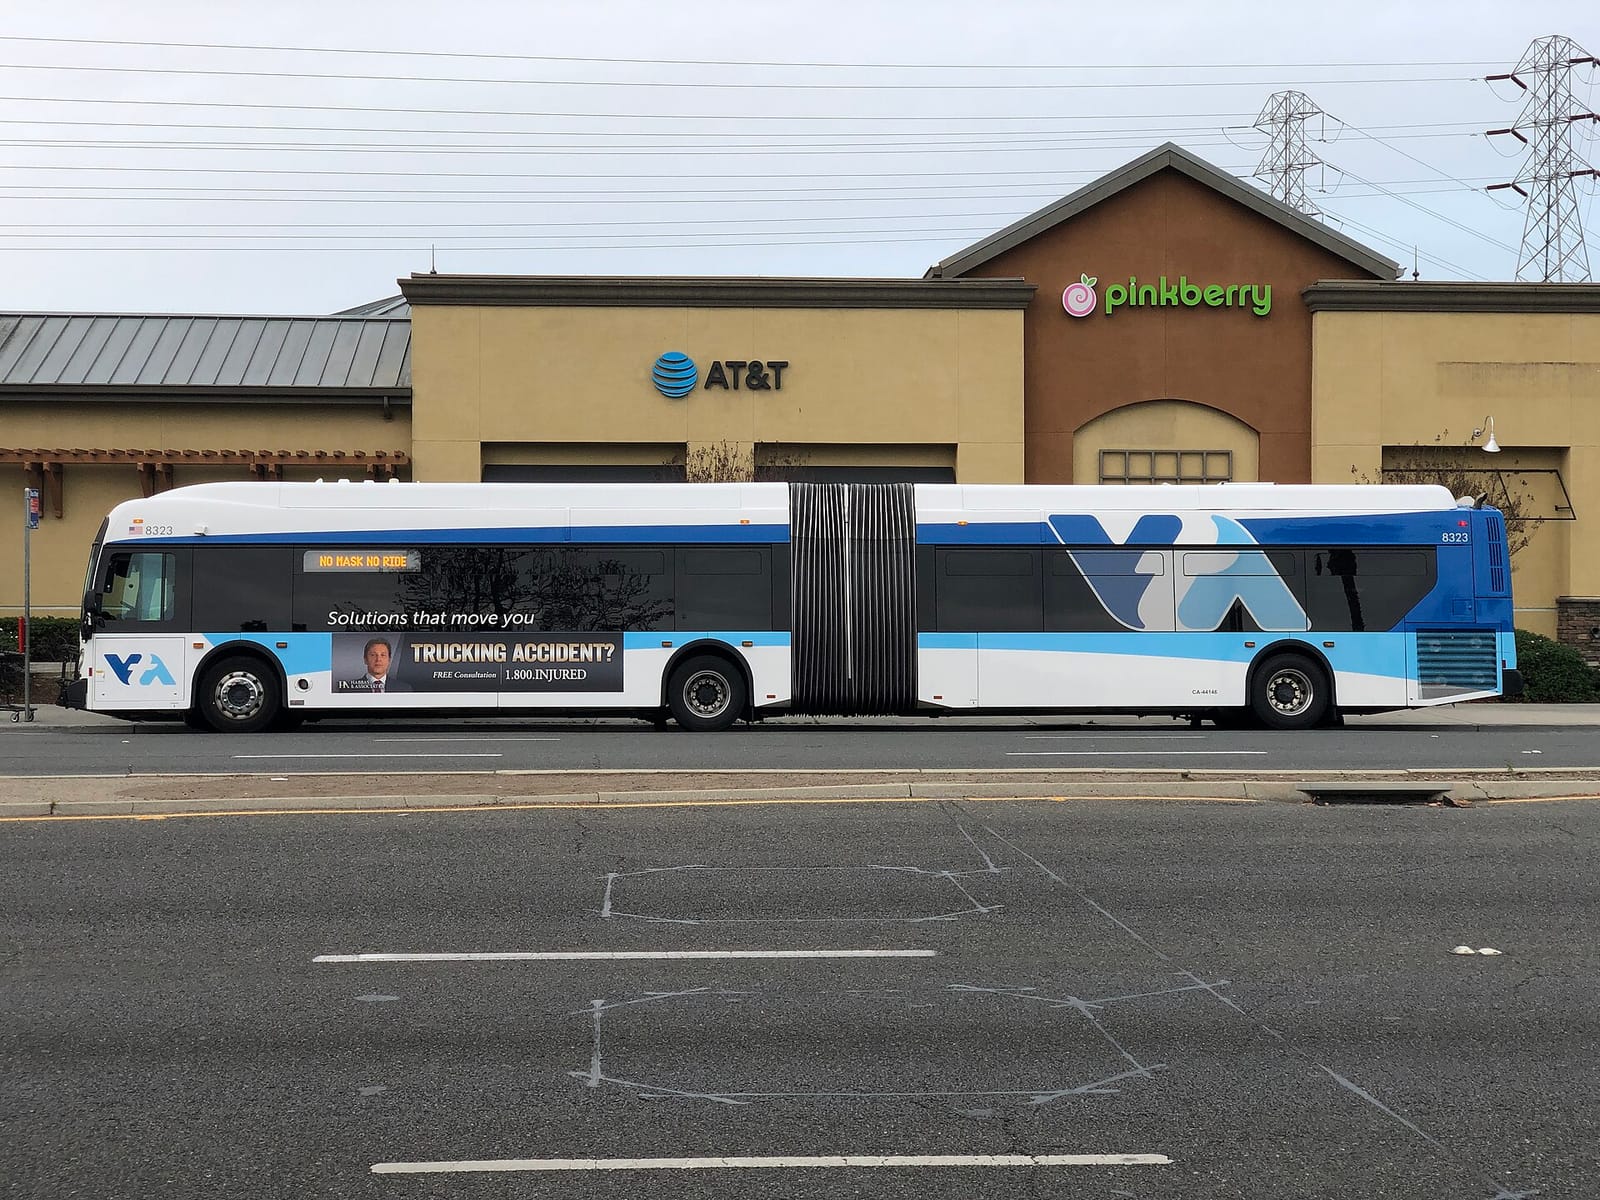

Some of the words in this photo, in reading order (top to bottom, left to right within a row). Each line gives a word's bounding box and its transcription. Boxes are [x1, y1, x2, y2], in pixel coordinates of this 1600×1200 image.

[1105, 275, 1272, 316] pinkberry
[703, 360, 789, 390] AT&T
[145, 525, 173, 536] 8323
[1442, 532, 1469, 543] 8323
[319, 555, 334, 567] NO
[336, 555, 364, 567] MASK
[366, 555, 380, 567] NO
[382, 555, 407, 567] RIDE
[327, 611, 408, 625] Solutions
[412, 611, 447, 625] that
[450, 614, 499, 625] move
[501, 613, 535, 628] you
[410, 643, 508, 663] TRUCKING
[512, 643, 616, 663] ACCIDENT?
[433, 671, 453, 679] FREE
[454, 670, 497, 679] Consultation
[505, 669, 587, 682] 1.800.INJURED
